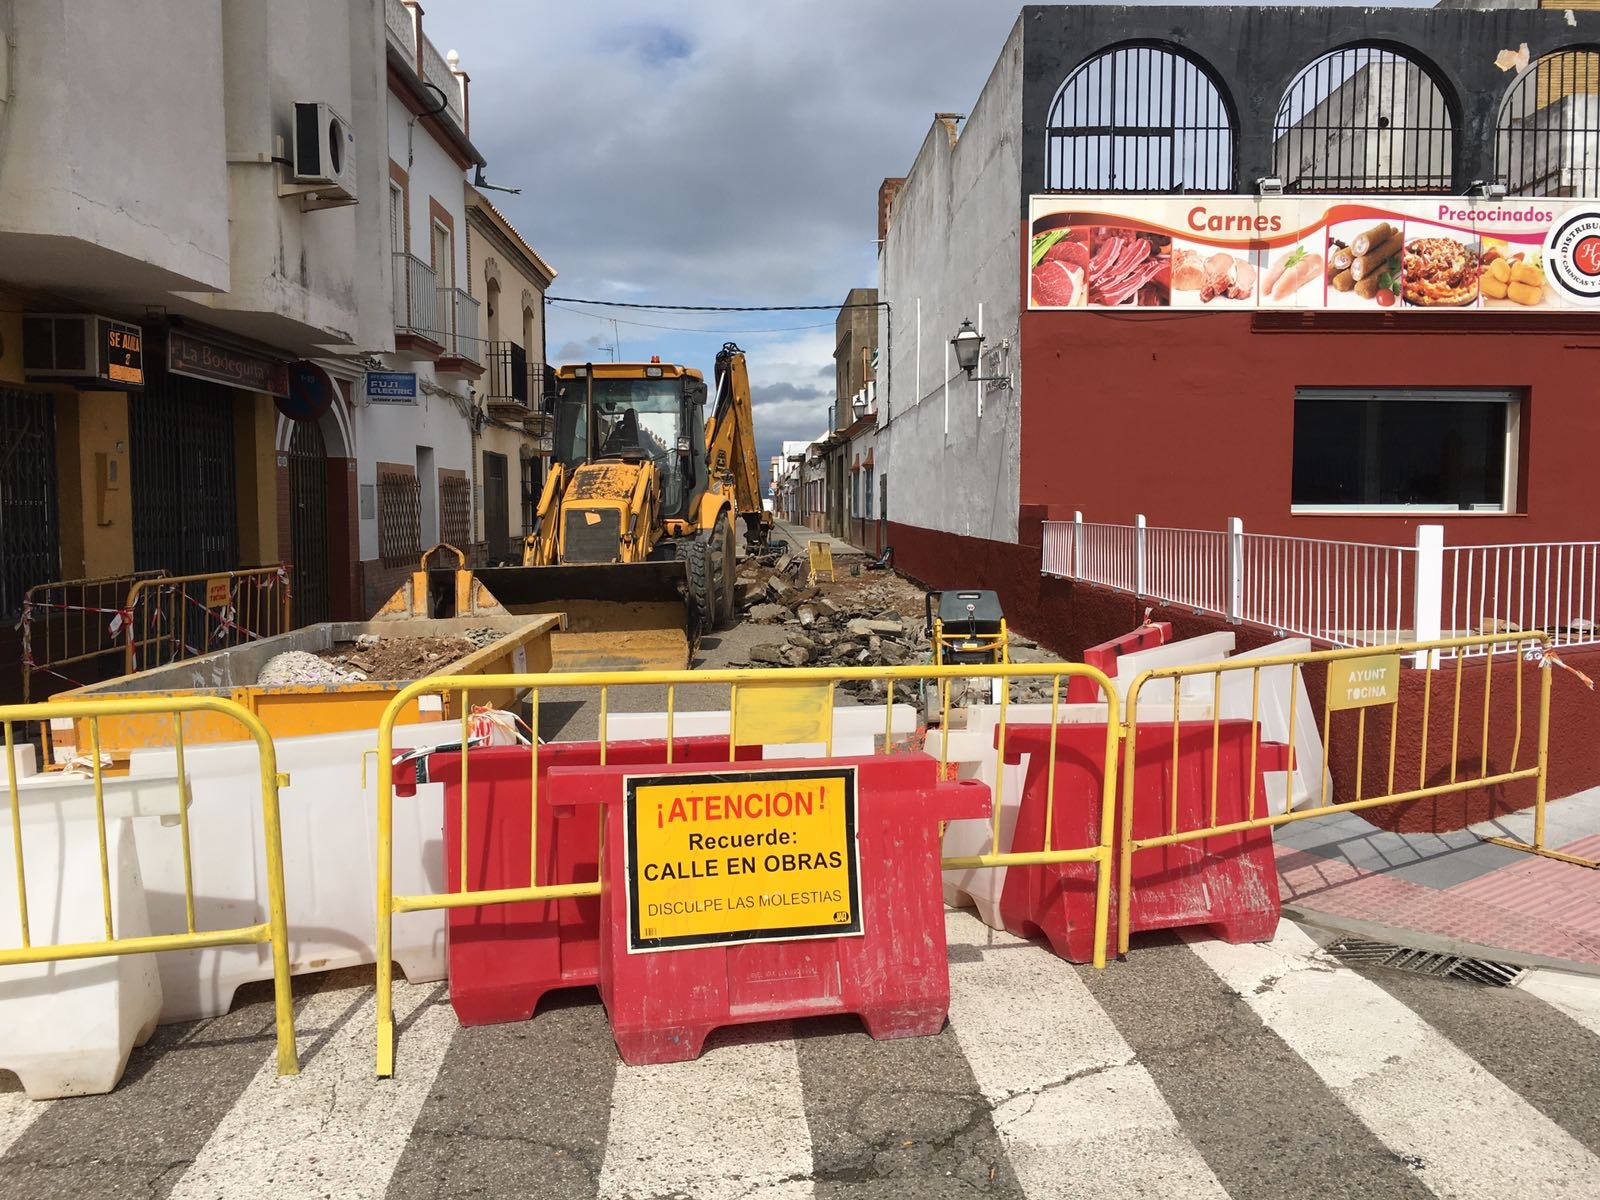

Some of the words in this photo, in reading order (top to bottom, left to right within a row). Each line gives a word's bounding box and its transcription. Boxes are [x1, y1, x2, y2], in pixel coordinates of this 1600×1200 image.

[1187, 206, 1282, 232] Carnes
[1438, 204, 1553, 222] Precocinados
[1561, 222, 1600, 253] DISTRIBU
[109, 331, 121, 347] SE
[182, 339, 198, 363] La
[370, 387, 413, 395] ELECTRIC
[1348, 668, 1387, 684] AYUNT
[1345, 685, 1387, 702] TOCINA
[688, 828, 798, 850] Recuerde:
[643, 858, 719, 882] CALLE
[727, 856, 756, 876] EN
[764, 851, 842, 873] OBRAS
[648, 898, 723, 917] DISCULPE
[727, 895, 755, 911] LAS
[759, 889, 843, 908] MOLESTIAS
